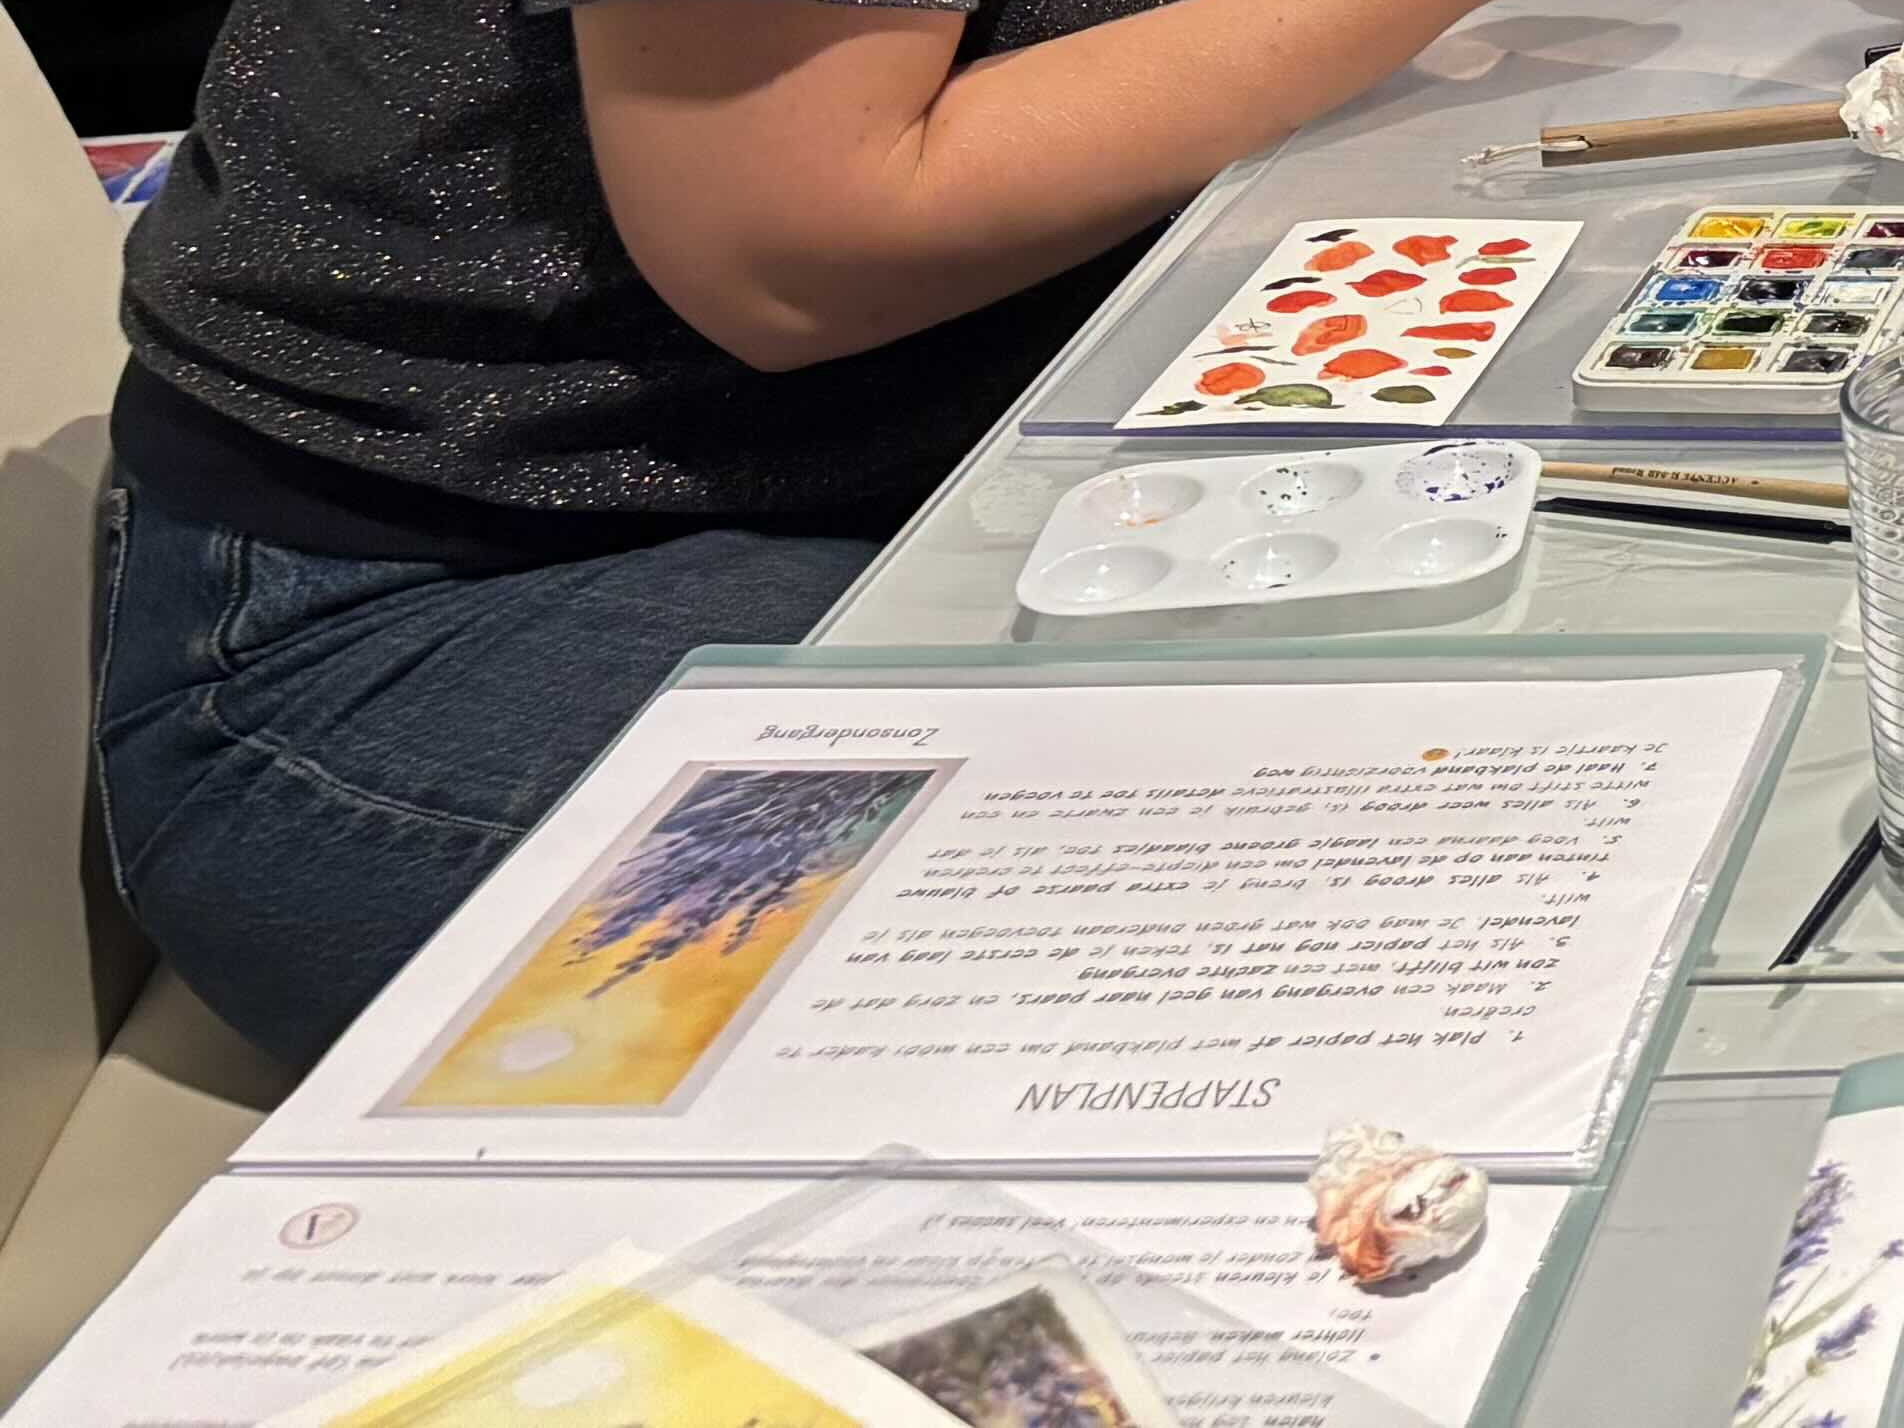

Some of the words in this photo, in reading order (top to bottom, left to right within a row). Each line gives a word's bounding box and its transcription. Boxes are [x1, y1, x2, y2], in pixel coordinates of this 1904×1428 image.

[755, 723, 940, 748] Zonsondergang
[1452, 746, 1524, 760] klaar!
[1529, 745, 1550, 756] is
[1554, 743, 1638, 757] kaartje
[1642, 742, 1669, 754] Je
[1252, 767, 1296, 779] weg
[1429, 761, 1540, 777] plakband
[1543, 763, 1573, 776] de
[1574, 762, 1626, 775] Haal
[1641, 761, 1657, 772] 7.
[1239, 877, 1309, 891] breng
[1363, 873, 1435, 888] droog
[1447, 873, 1503, 888] alles
[1515, 872, 1551, 887] Als
[1581, 871, 1601, 882] 4.
[895, 886, 978, 900] blauwe
[984, 884, 1021, 900] of
[1031, 880, 1118, 895] paarse
[1124, 881, 1191, 893] extra
[1202, 878, 1231, 893] je
[1541, 892, 1592, 908] wilt.
[1071, 922, 1187, 937] onderaan
[1194, 917, 1265, 933] groen
[1270, 919, 1318, 932] wat
[1326, 918, 1371, 932] ook
[1378, 915, 1431, 929] mag
[1436, 916, 1466, 930] Je
[861, 927, 891, 944] je
[895, 929, 934, 944] als
[938, 925, 1063, 941] toevoegen
[1239, 942, 1286, 955] nat
[1293, 938, 1340, 953] nog
[1346, 935, 1433, 952] papier
[1436, 939, 1481, 952] het
[1489, 937, 1525, 952] Als
[1550, 935, 1571, 948] 3.
[845, 951, 891, 964] van
[899, 949, 953, 965] laag
[959, 948, 1039, 961] eerste
[1047, 947, 1081, 961] de
[1087, 943, 1116, 960] je
[1121, 943, 1192, 958] teken
[1282, 963, 1328, 975] een
[1332, 962, 1382, 976] met
[1391, 959, 1465, 977] blijft,
[1469, 959, 1510, 972] wit
[1515, 957, 1561, 969] zon
[1077, 965, 1191, 981] overgang
[1195, 964, 1280, 980] zachte
[1219, 987, 1264, 1000] van
[1271, 983, 1385, 999] overgang
[1392, 983, 1436, 995] een
[1446, 981, 1509, 997] Maak
[1530, 980, 1553, 993] 2.
[901, 993, 963, 1009] zorg
[967, 994, 1000, 1006] en
[1011, 988, 1091, 1006] paars,
[1092, 991, 1153, 1004] naar
[1156, 986, 1215, 1006] geel
[810, 998, 846, 1013] de
[850, 997, 897, 1011] dat
[1060, 1035, 1187, 1057] plakband
[1190, 1037, 1243, 1051] met
[1247, 1035, 1283, 1053] af
[1287, 1030, 1377, 1048] papier
[1378, 1032, 1424, 1048] het
[1431, 1030, 1487, 1047] Plak
[775, 1047, 803, 1059] te
[807, 1045, 889, 1062] kader
[893, 1043, 958, 1057] mooi
[964, 1042, 1011, 1055] een
[1019, 1042, 1058, 1055] om
[1015, 1077, 1281, 1112] STAPPENPLAN
[948, 1215, 1020, 1229] succes
[1025, 1215, 1067, 1232] Veel
[1072, 1211, 1250, 1231] experimenteren!
[1255, 1215, 1279, 1225] en
[1199, 1250, 1224, 1267] je
[1229, 1252, 1304, 1268] zonder
[1215, 1271, 1299, 1288] kleuren
[1309, 1269, 1332, 1286] je
[1291, 1328, 1368, 1344] lichter
[1151, 1348, 1228, 1364] papier
[1235, 1350, 1271, 1367] het
[1279, 1348, 1358, 1366] Zolang
[1249, 1392, 1335, 1410] kleuren
